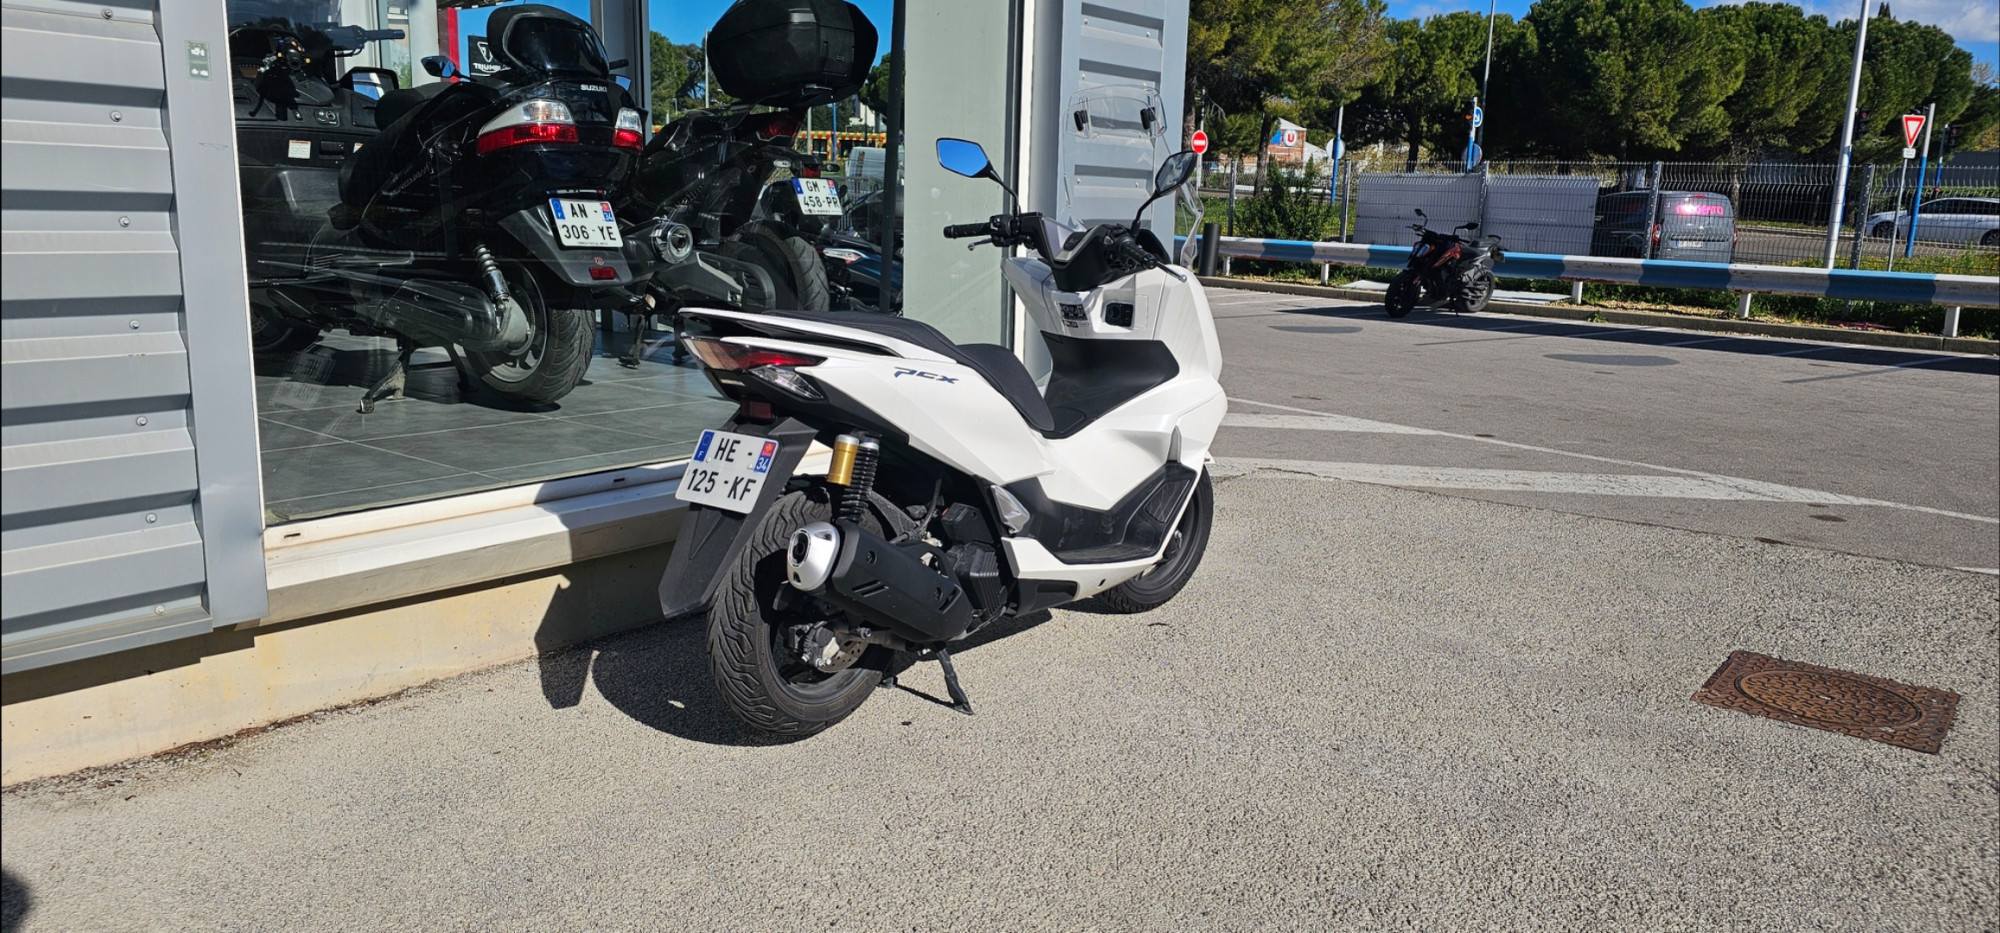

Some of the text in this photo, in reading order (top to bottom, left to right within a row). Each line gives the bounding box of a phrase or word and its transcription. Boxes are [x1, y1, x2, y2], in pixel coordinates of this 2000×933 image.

[580, 84, 608, 92] SUZUKI
[1287, 133, 1295, 143] U
[805, 181, 820, 192] GM
[570, 203, 588, 218] AN
[894, 366, 960, 384] PCX
[714, 437, 741, 462] HE
[756, 457, 767, 471] 34
